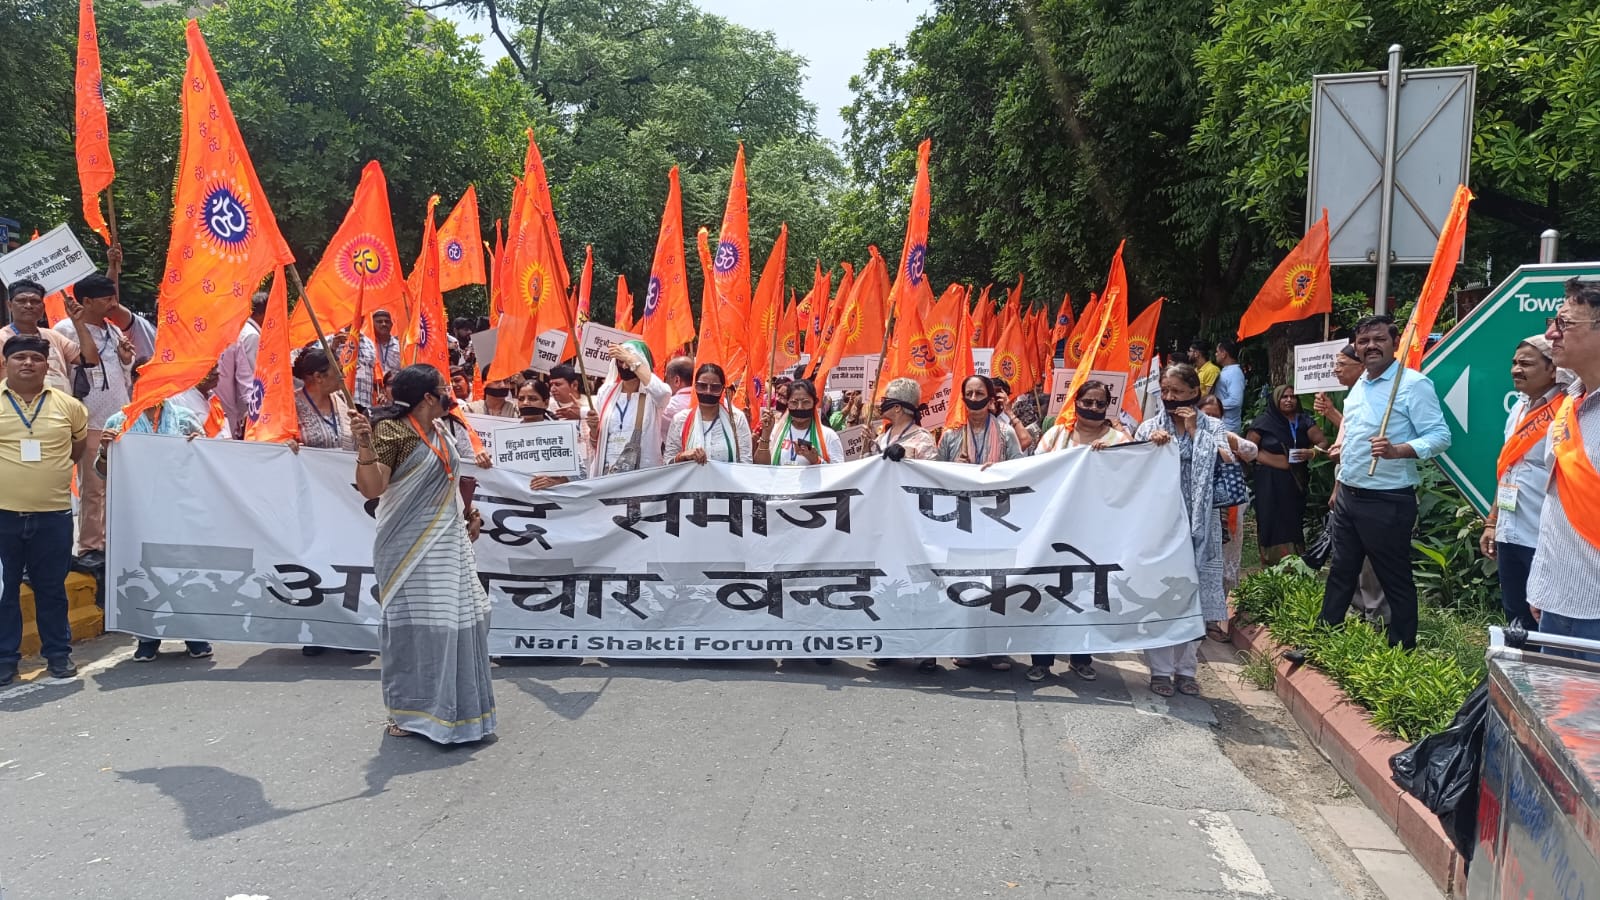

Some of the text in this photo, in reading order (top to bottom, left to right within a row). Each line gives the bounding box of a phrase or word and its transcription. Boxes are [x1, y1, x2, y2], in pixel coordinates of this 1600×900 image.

[1515, 293, 1565, 312] Towa
[600, 487, 863, 540] समाज
[902, 485, 1034, 533] पर
[702, 567, 888, 621] बन्द
[931, 542, 1124, 616] करो
[515, 635, 883, 654] Nari Shakti Forum (NSF)
